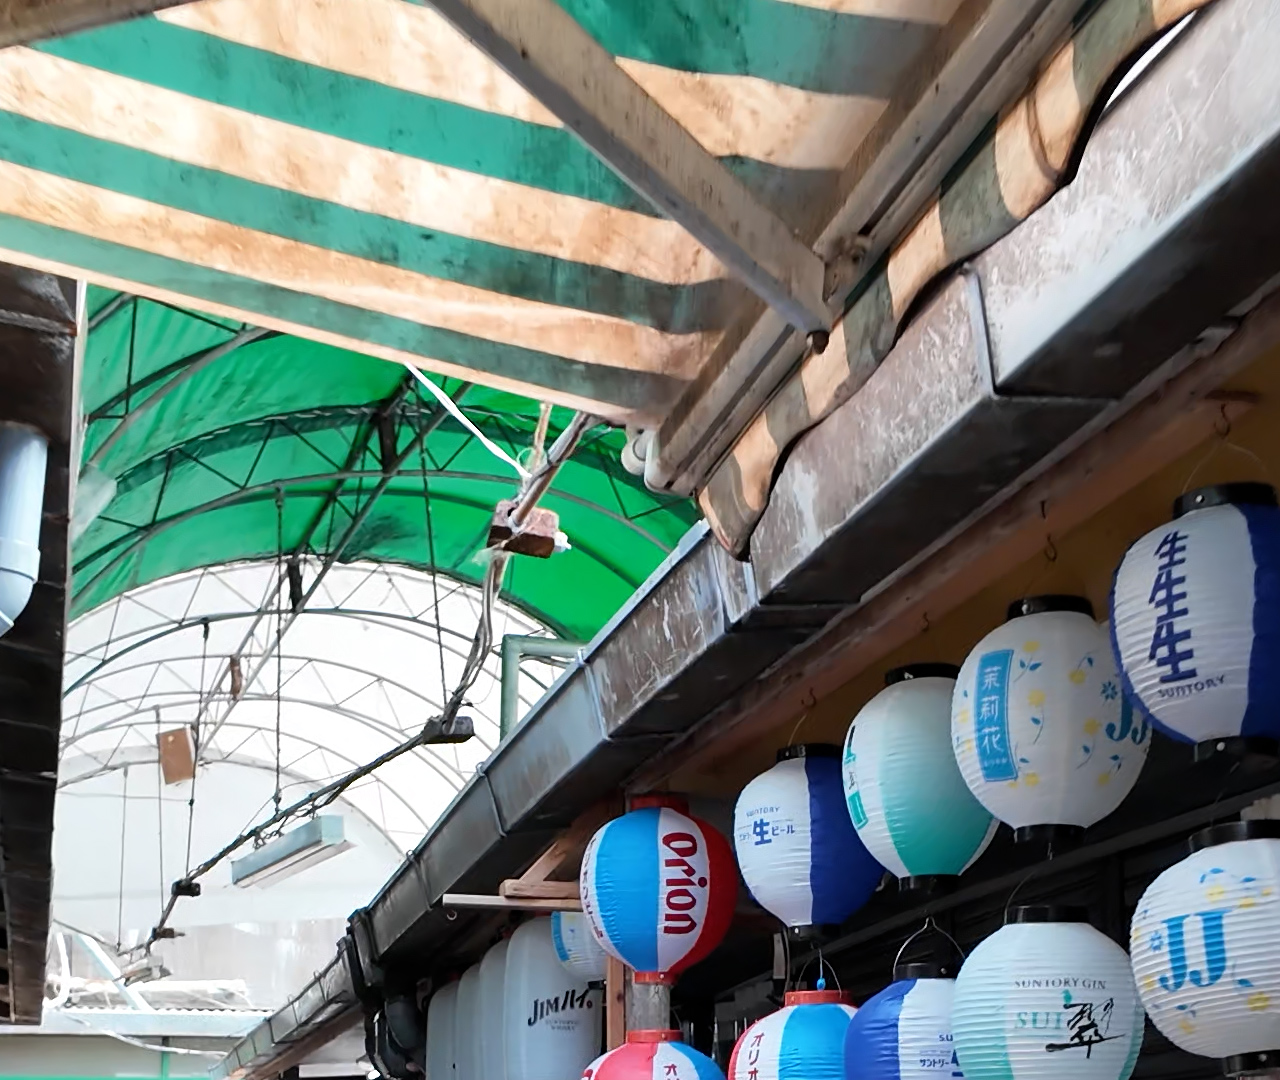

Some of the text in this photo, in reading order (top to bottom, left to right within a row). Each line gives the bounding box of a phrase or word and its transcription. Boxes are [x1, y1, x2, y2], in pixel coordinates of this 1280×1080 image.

[1148, 530, 1198, 684] 生生生
[1156, 674, 1226, 699] SUNTORY
[662, 831, 708, 935] Orion
[1158, 908, 1235, 992] JJ
[1014, 977, 1107, 990] SUNTORY GIN
[1013, 1011, 1063, 1030] SUI
